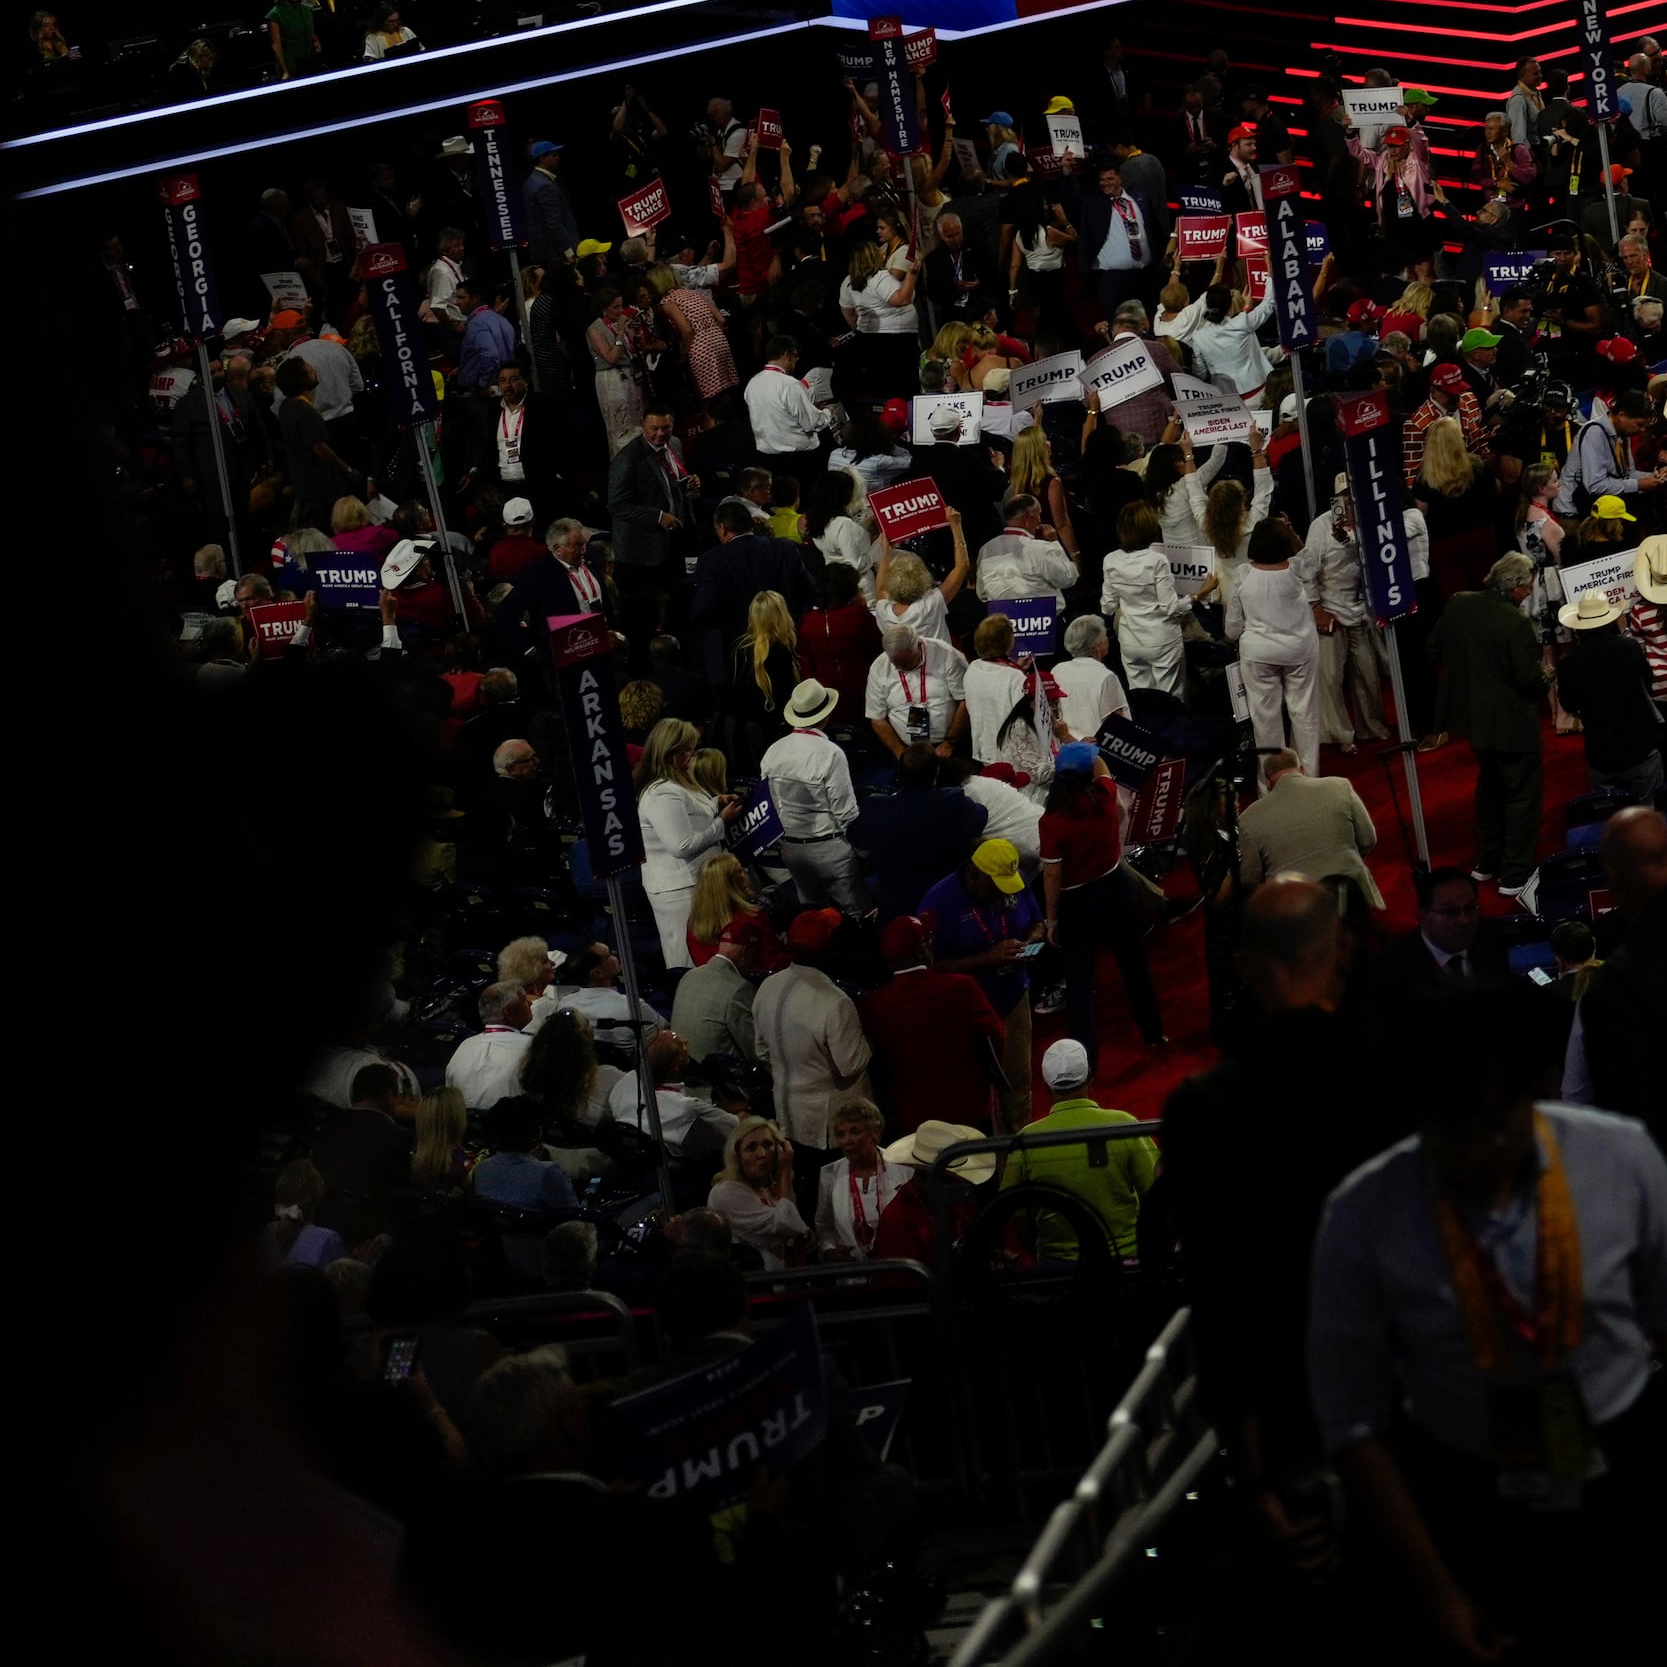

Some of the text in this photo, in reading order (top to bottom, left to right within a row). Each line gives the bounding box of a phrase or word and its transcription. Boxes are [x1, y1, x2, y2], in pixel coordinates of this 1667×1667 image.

[882, 40, 909, 148] NEW HAMPSHIRE
[1590, 50, 1610, 113] YORK
[482, 129, 513, 241] TENNESSEE
[624, 189, 664, 216] TRUMP
[633, 200, 664, 222] VANCE
[1180, 195, 1222, 211] TRUMP
[1183, 228, 1226, 242] TRUMP
[1242, 225, 1269, 238] TRU
[182, 204, 216, 330] GEORGIA
[1277, 199, 1309, 340] ALABAMA
[381, 278, 425, 415] CALIFORNIA
[1016, 366, 1077, 394] TRUMP
[1091, 354, 1147, 390] TRUMP
[1186, 403, 1242, 420] AMERICA FIRST
[1197, 402, 1223, 413] TRUMP
[1193, 420, 1248, 437] AMERICA LAST
[1207, 417, 1231, 429] BIDEN
[880, 492, 940, 518] TRUMP
[1369, 437, 1403, 607] ILLINOIS
[316, 568, 378, 584] TRUMP
[1170, 562, 1209, 578] UMP
[1590, 565, 1622, 581] TRUMP
[1573, 577, 1615, 594] AMERICA
[1012, 616, 1053, 634] RUMP
[1101, 732, 1157, 768] TRUMP
[579, 669, 626, 858] ARKANSAS
[1150, 766, 1172, 837] TRUMP
